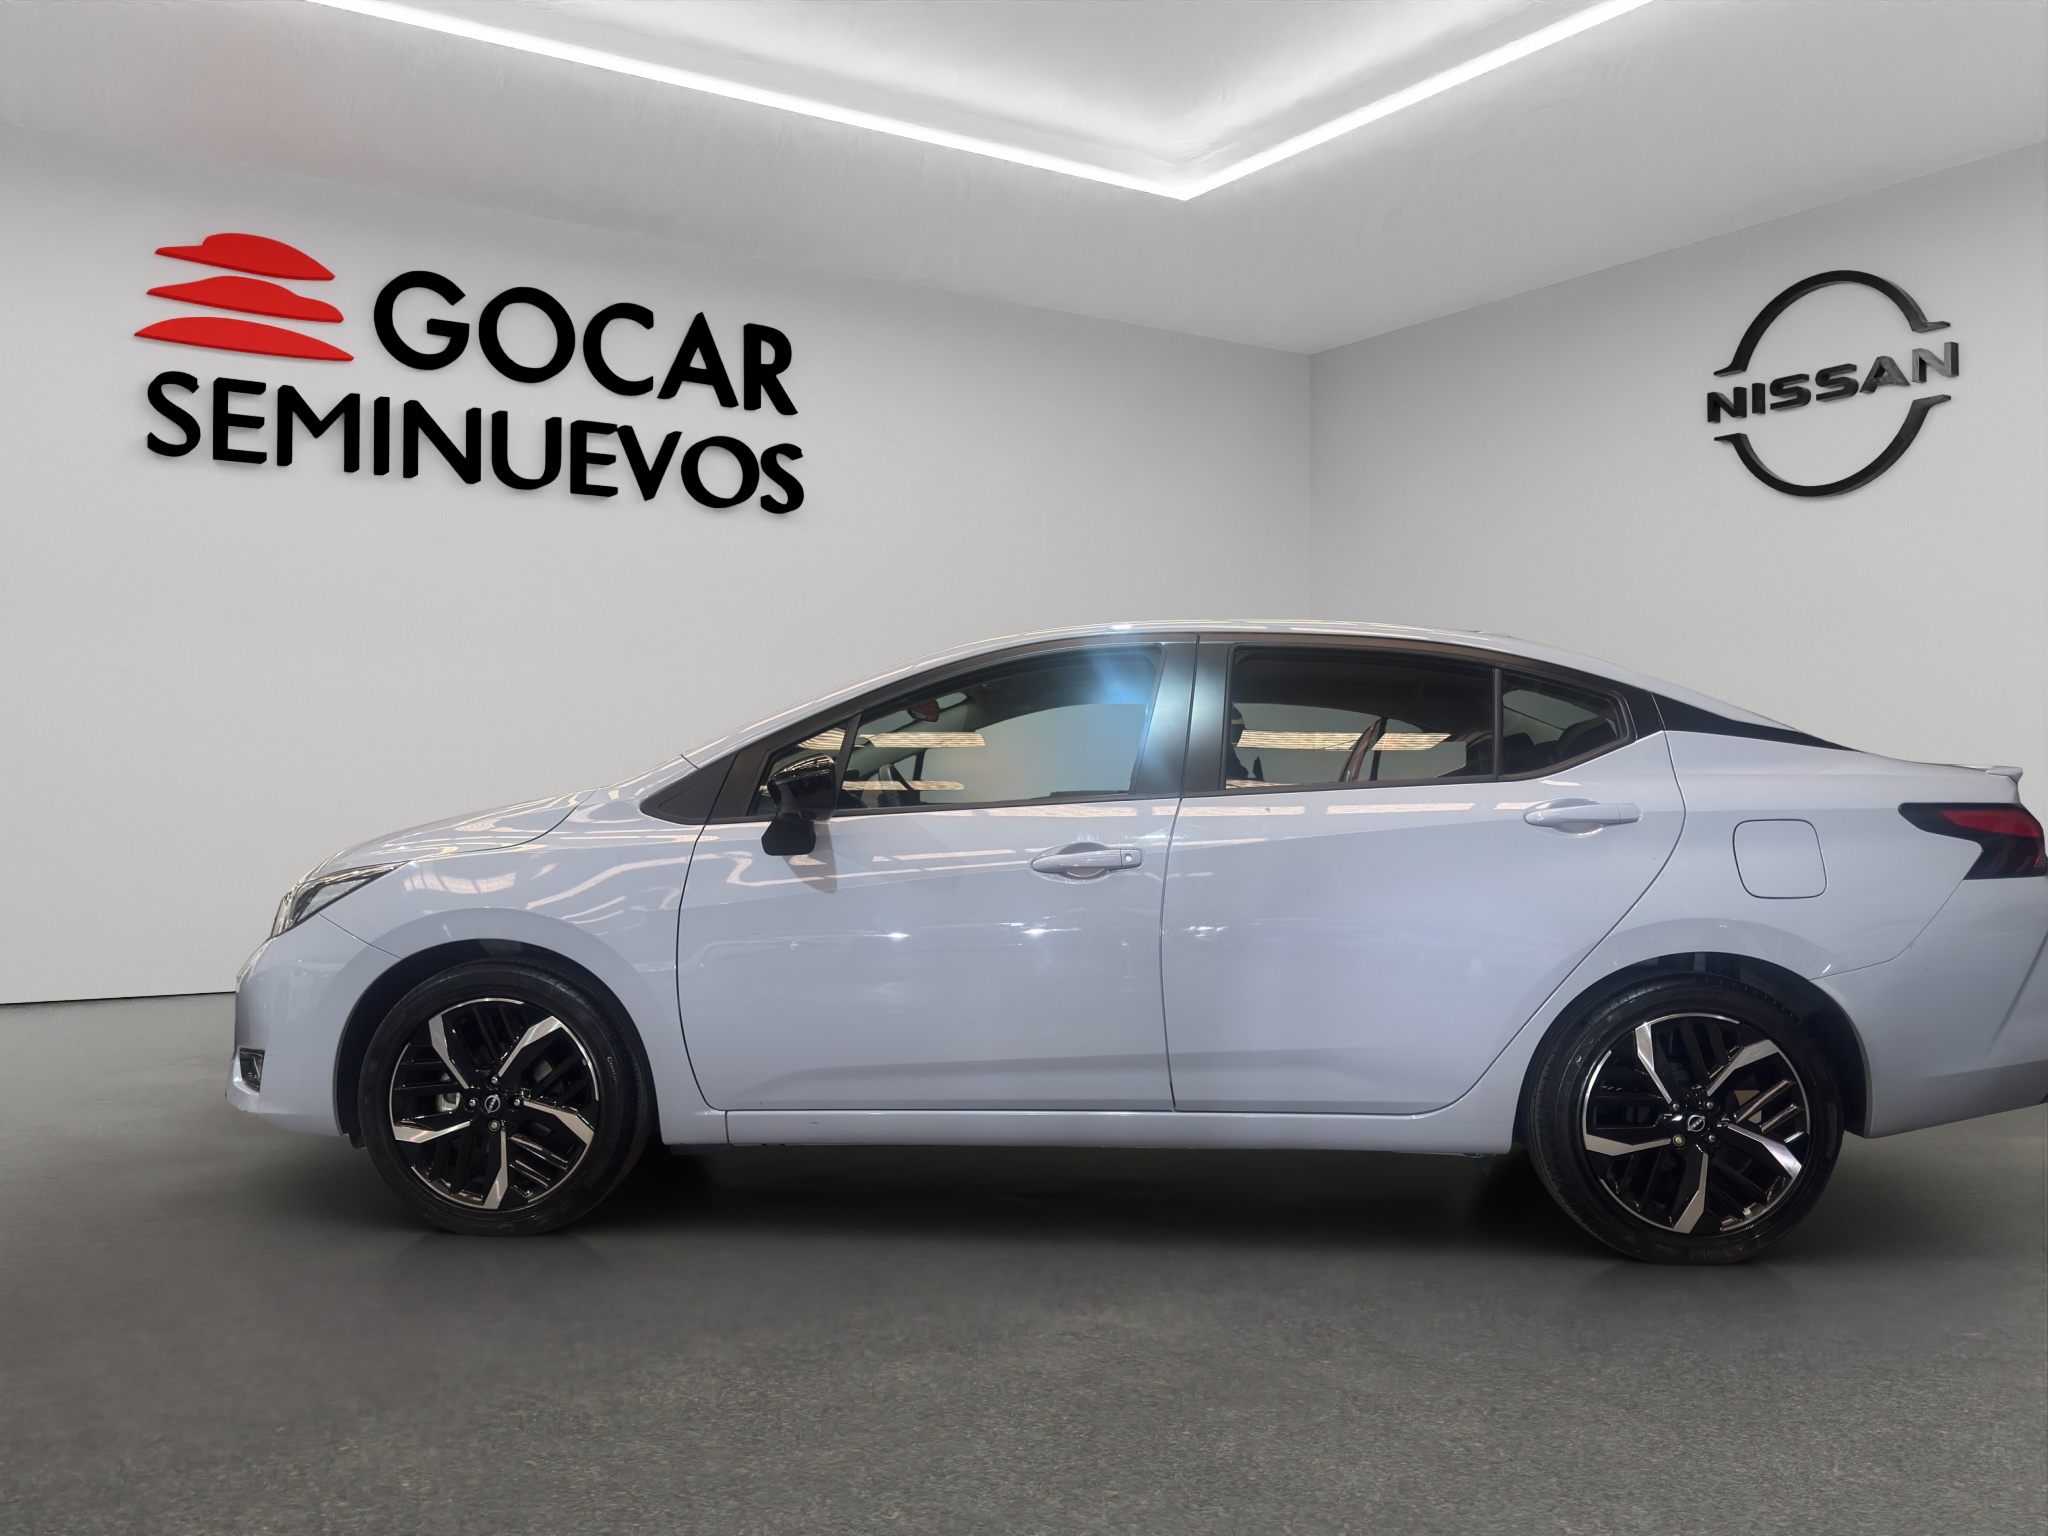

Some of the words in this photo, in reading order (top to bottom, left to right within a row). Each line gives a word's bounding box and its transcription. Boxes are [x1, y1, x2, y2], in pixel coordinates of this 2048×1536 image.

[373, 270, 799, 416] GOCAR
[1706, 341, 1960, 424] NISSAN
[146, 370, 806, 515] SEMINUEVOS
